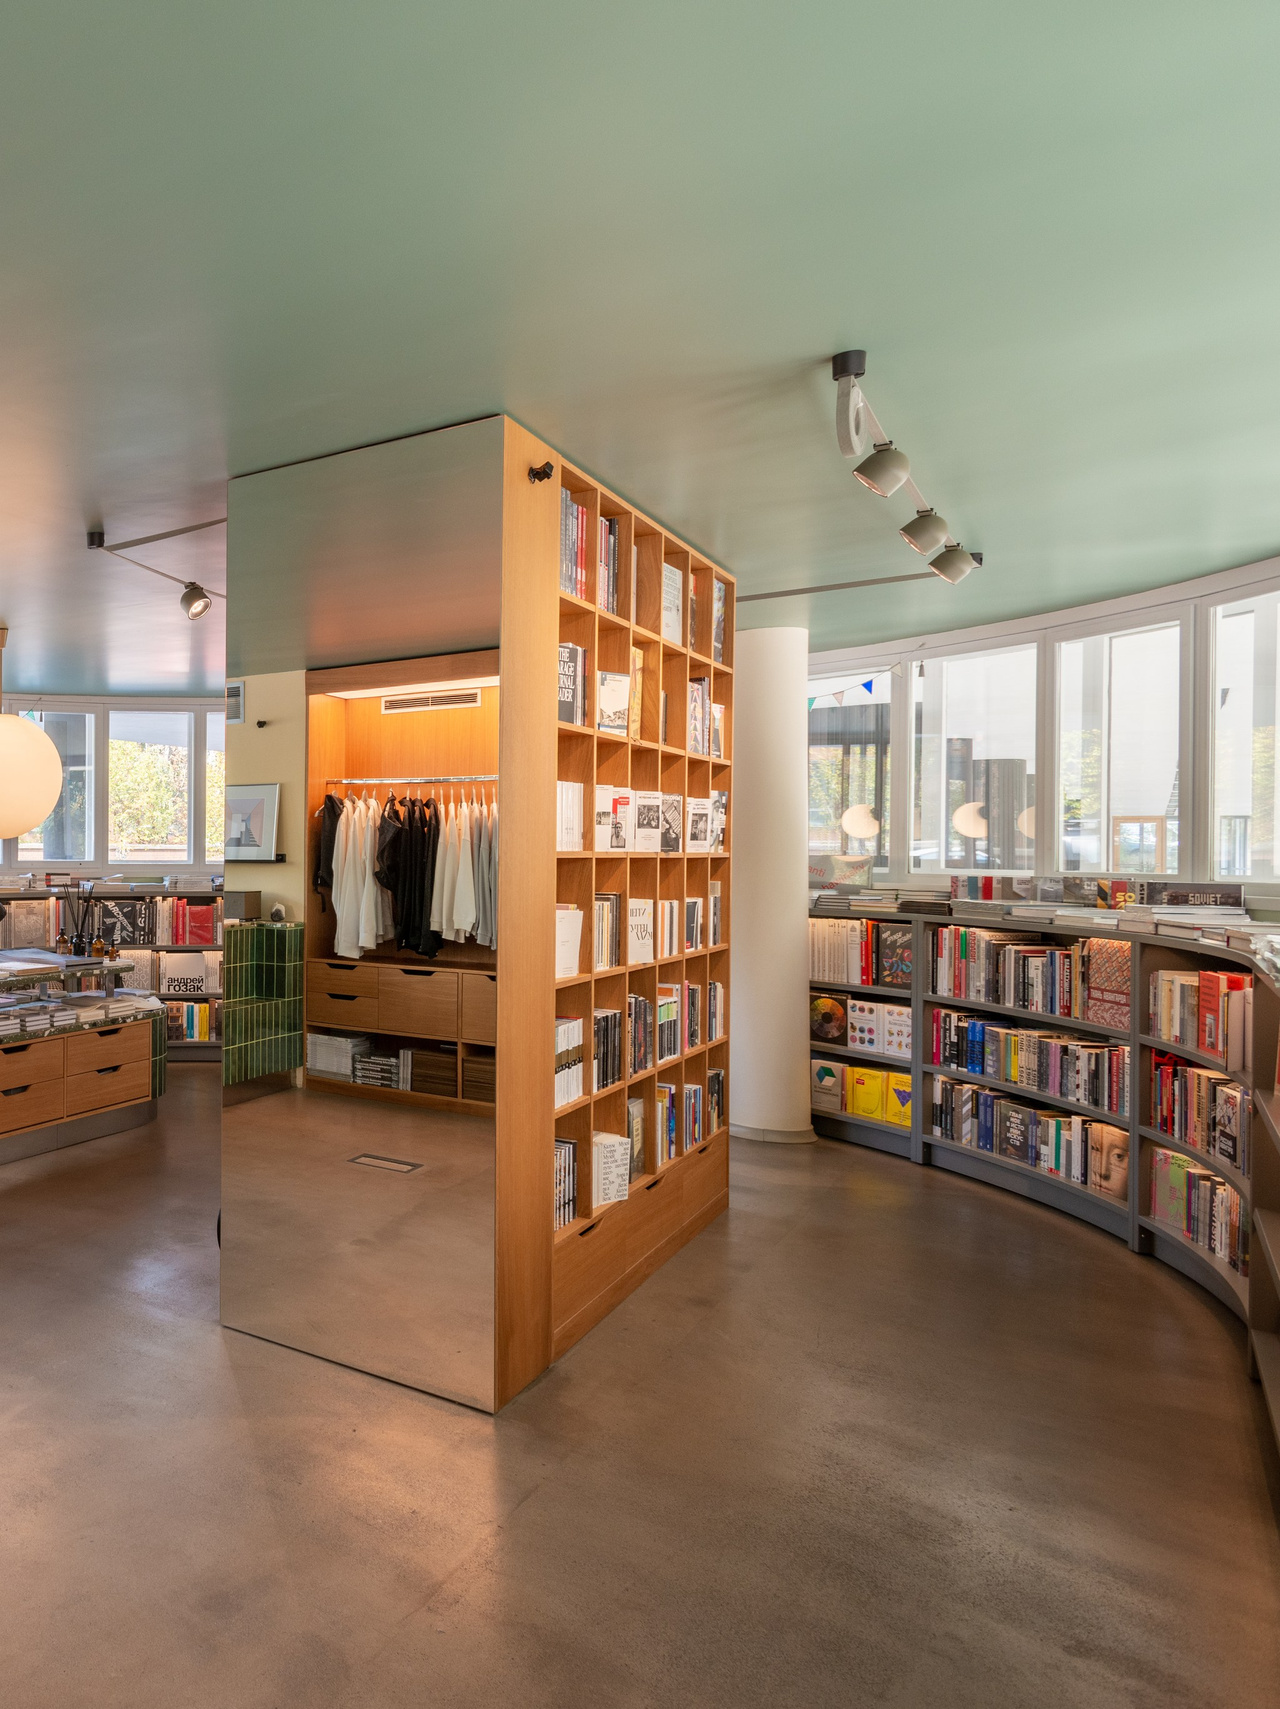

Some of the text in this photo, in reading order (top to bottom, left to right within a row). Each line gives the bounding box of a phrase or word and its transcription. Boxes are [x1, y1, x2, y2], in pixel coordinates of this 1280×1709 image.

[558, 662, 574, 676] RAGE
[558, 688, 573, 702] ADER
[1188, 893, 1222, 905] SOVIET
[167, 975, 204, 986] андрей
[167, 984, 204, 993] гозак
